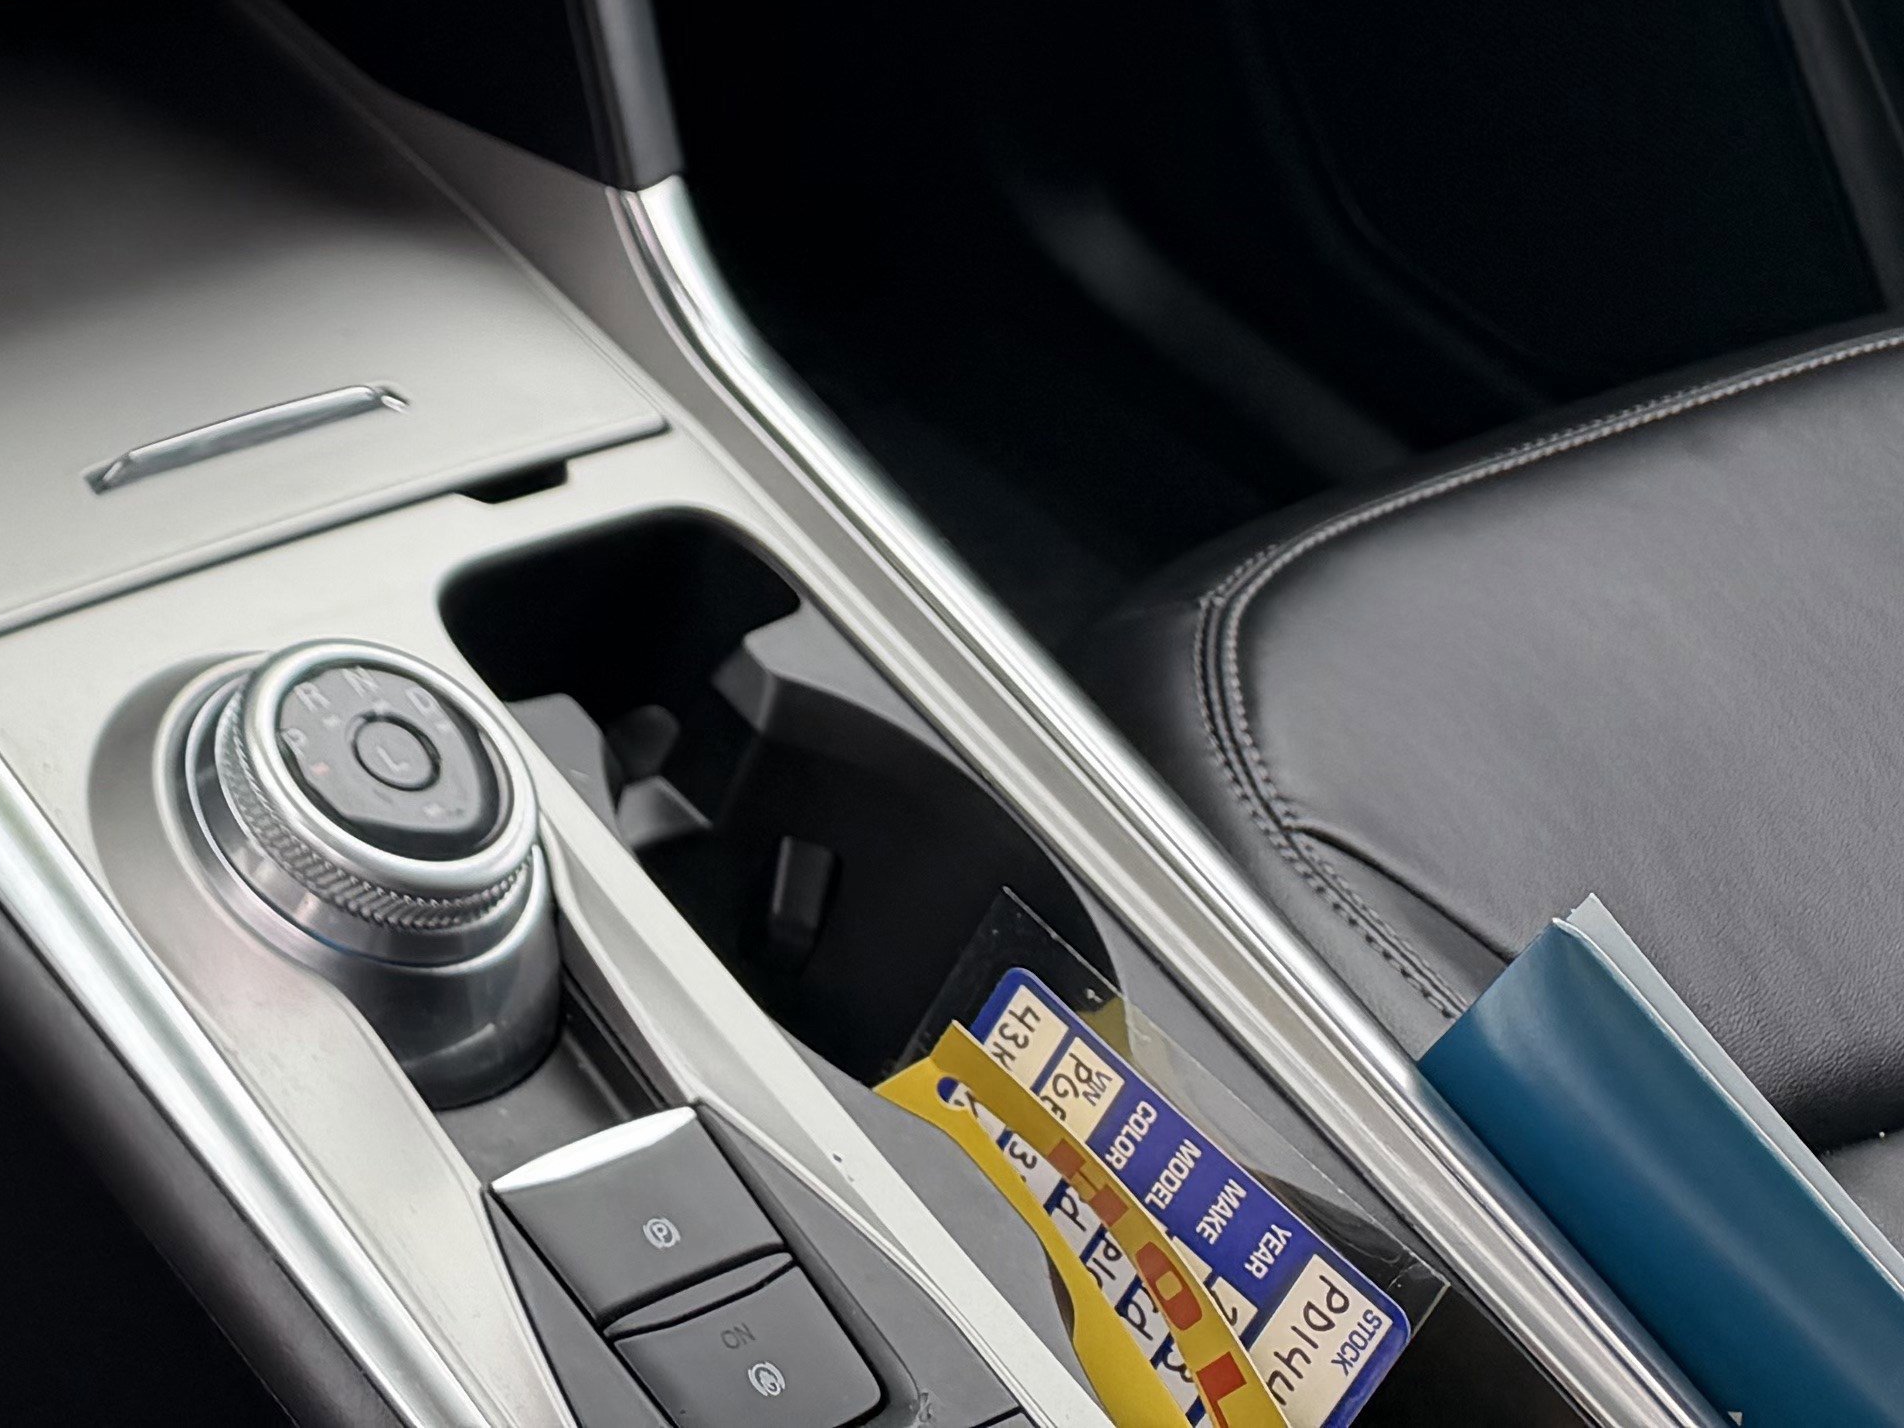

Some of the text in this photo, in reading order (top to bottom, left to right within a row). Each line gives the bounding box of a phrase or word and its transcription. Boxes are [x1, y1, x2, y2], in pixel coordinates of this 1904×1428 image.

[295, 682, 330, 712] R
[1082, 1070, 1113, 1107] VIN
[1105, 1100, 1157, 1171] COLOR
[1144, 1139, 1201, 1211] MODEL
[1196, 1179, 1247, 1245] MAKE
[1245, 1223, 1292, 1280] YEAR
[1331, 1309, 1382, 1376] STOCK
